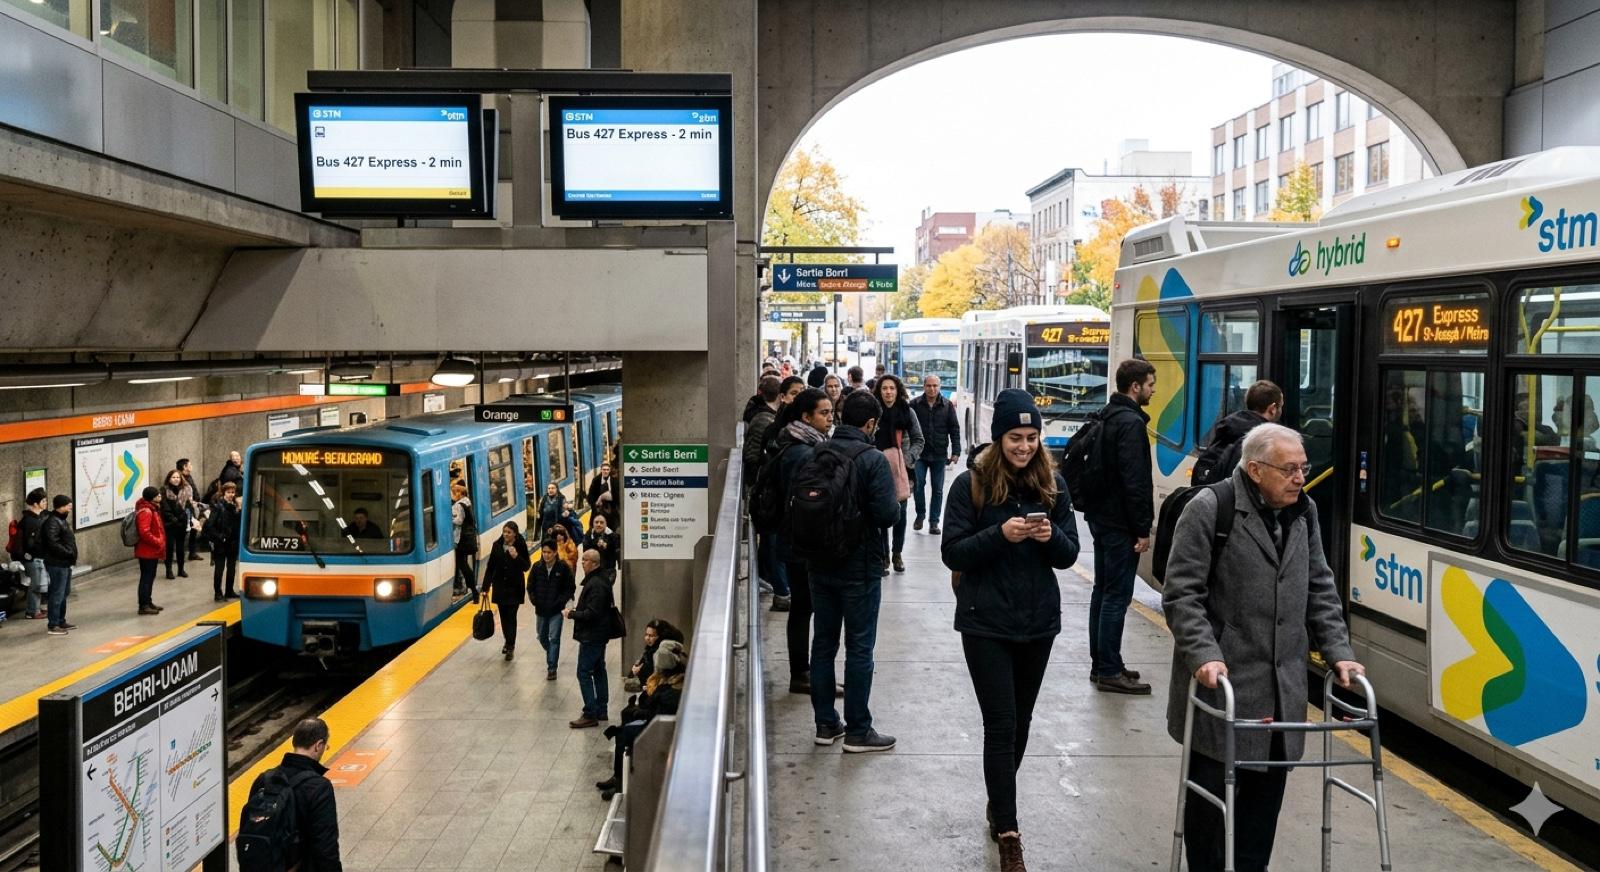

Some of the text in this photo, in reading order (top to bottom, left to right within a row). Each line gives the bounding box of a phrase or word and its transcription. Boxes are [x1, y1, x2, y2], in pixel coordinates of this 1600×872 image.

[567, 128, 590, 139] Bus
[594, 128, 615, 139] 427
[619, 128, 668, 142] Express
[678, 128, 686, 139] 2
[690, 128, 712, 139] min
[316, 156, 340, 167] Bus
[343, 156, 365, 167] 427
[368, 156, 418, 170] Express
[428, 156, 436, 167] 2
[440, 156, 462, 168] min
[1538, 207, 1598, 253] stm
[1316, 231, 1367, 277] hybrid
[1041, 327, 1064, 343] 427
[1393, 305, 1479, 342] 427 Express
[482, 410, 519, 422] Orange
[260, 537, 299, 550] MR-73
[1374, 553, 1423, 604] stm
[114, 651, 198, 717] BERRI-UQAM
